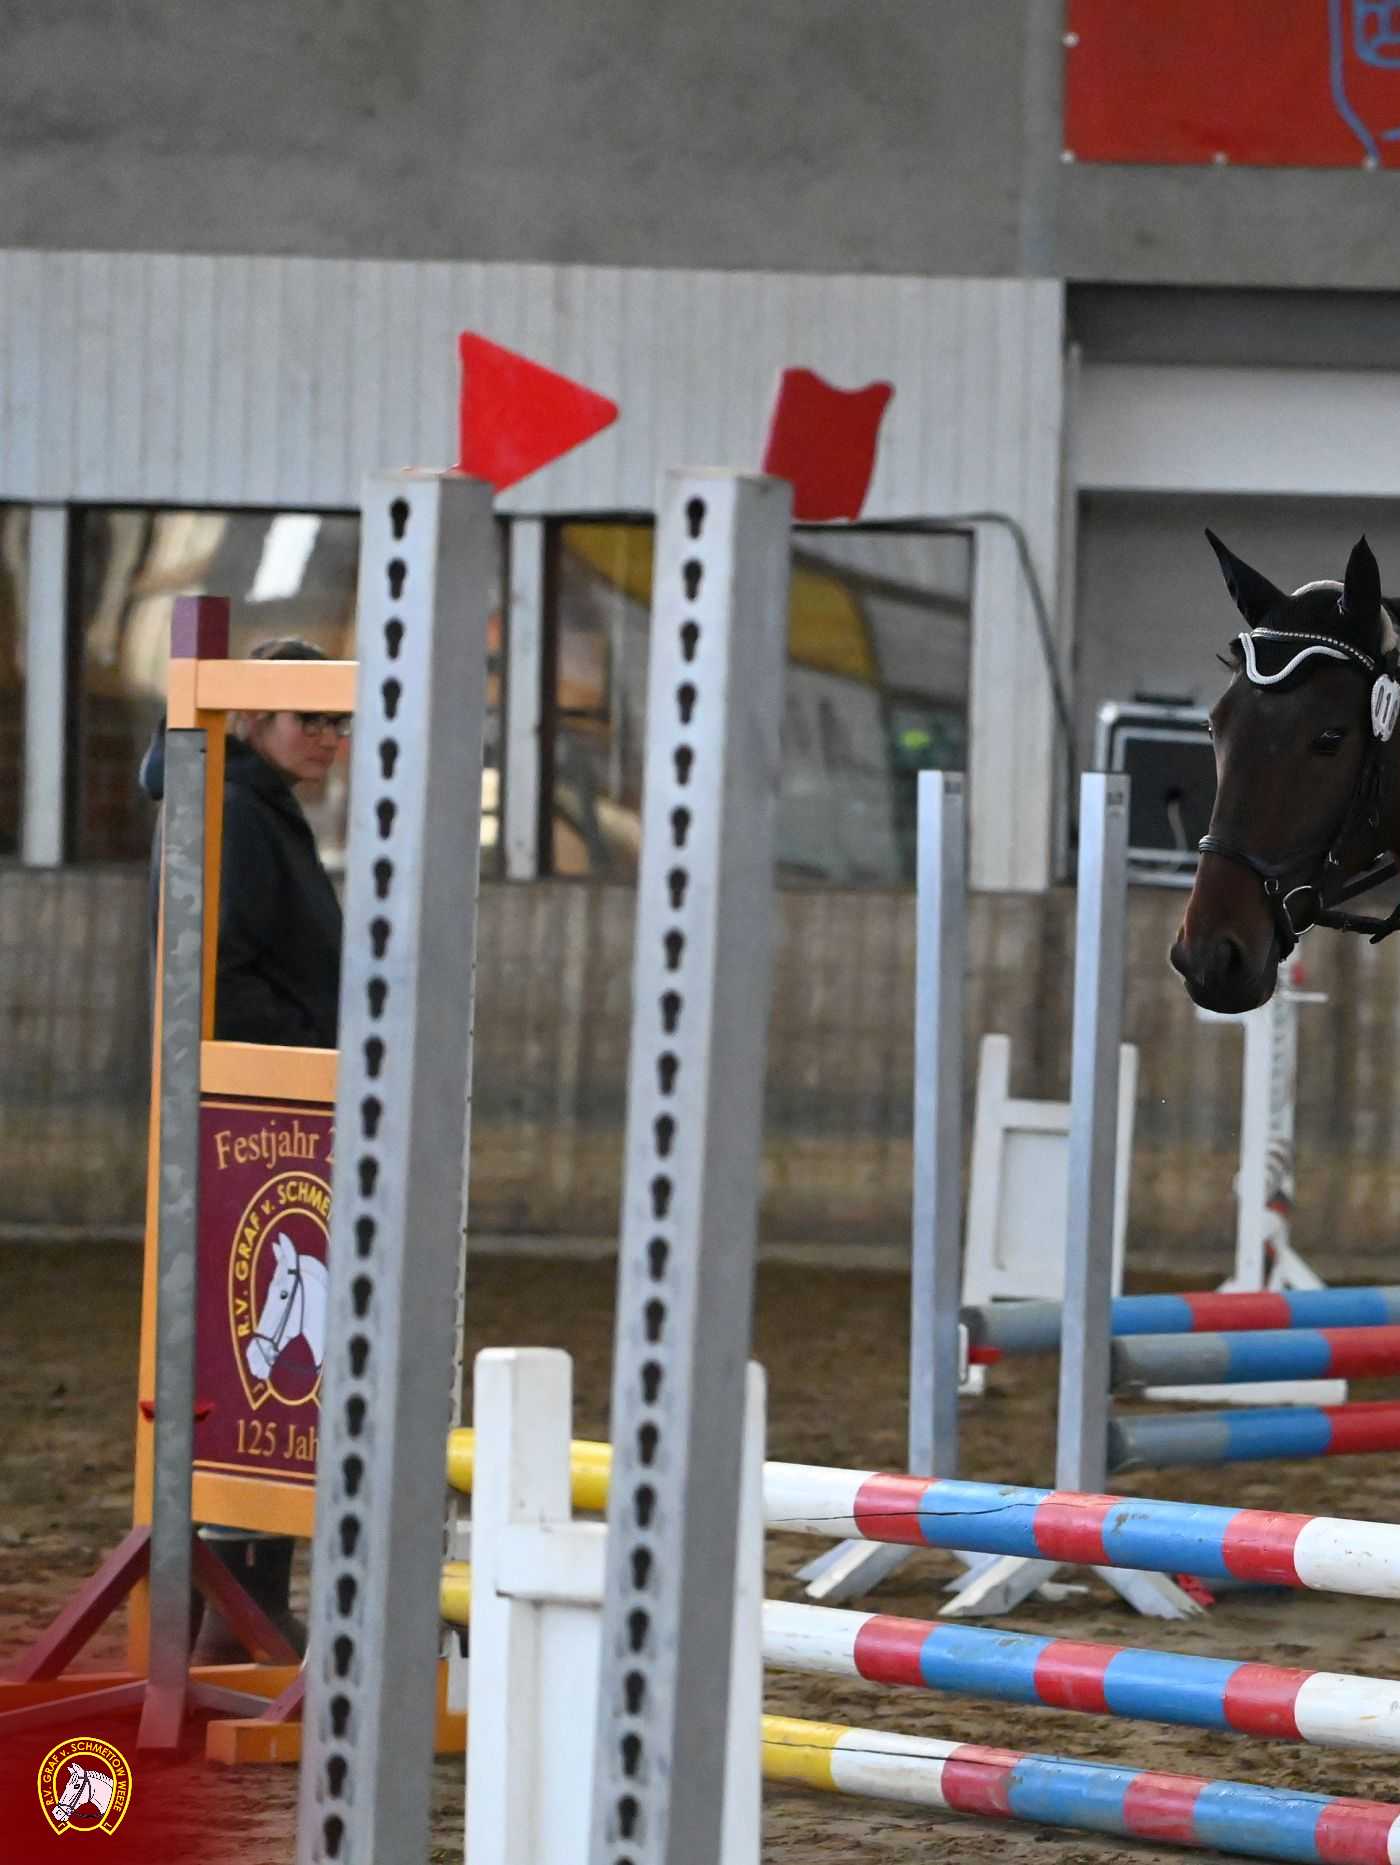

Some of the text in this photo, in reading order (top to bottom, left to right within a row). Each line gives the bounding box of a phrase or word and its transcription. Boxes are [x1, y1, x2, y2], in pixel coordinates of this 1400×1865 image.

[213, 1119, 320, 1170] Festjahr
[235, 1210, 260, 1281] GRAF
[276, 1180, 332, 1221] SCHME
[236, 1418, 320, 1462] 125 Jah
